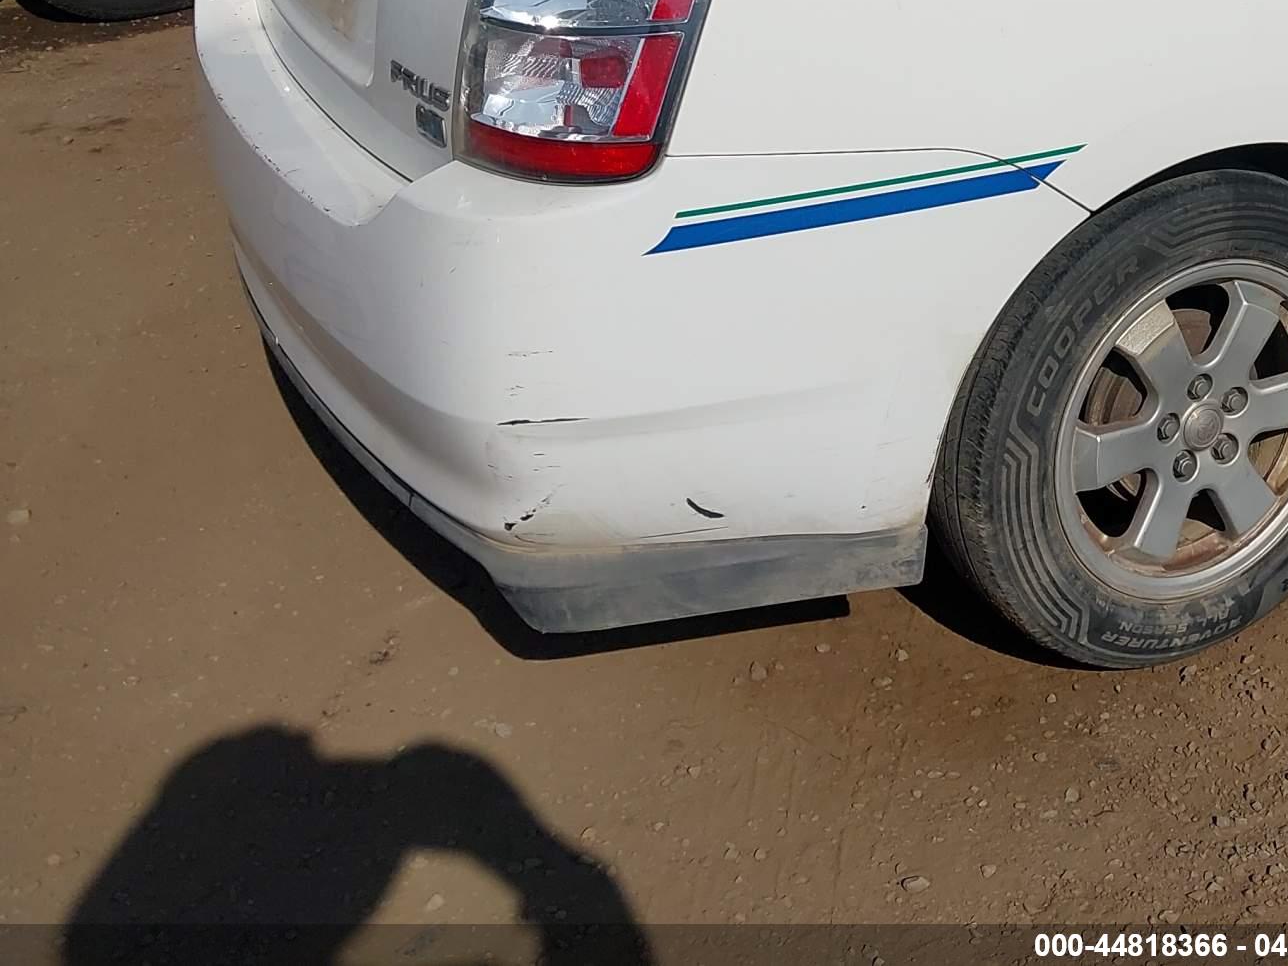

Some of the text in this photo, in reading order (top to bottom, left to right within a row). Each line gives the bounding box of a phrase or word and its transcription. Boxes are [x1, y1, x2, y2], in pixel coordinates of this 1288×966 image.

[390, 59, 451, 112] PRIUS
[1026, 256, 1139, 417] COOPER
[1101, 615, 1243, 650] ADVENTURER
[1119, 620, 1190, 635] SEASON
